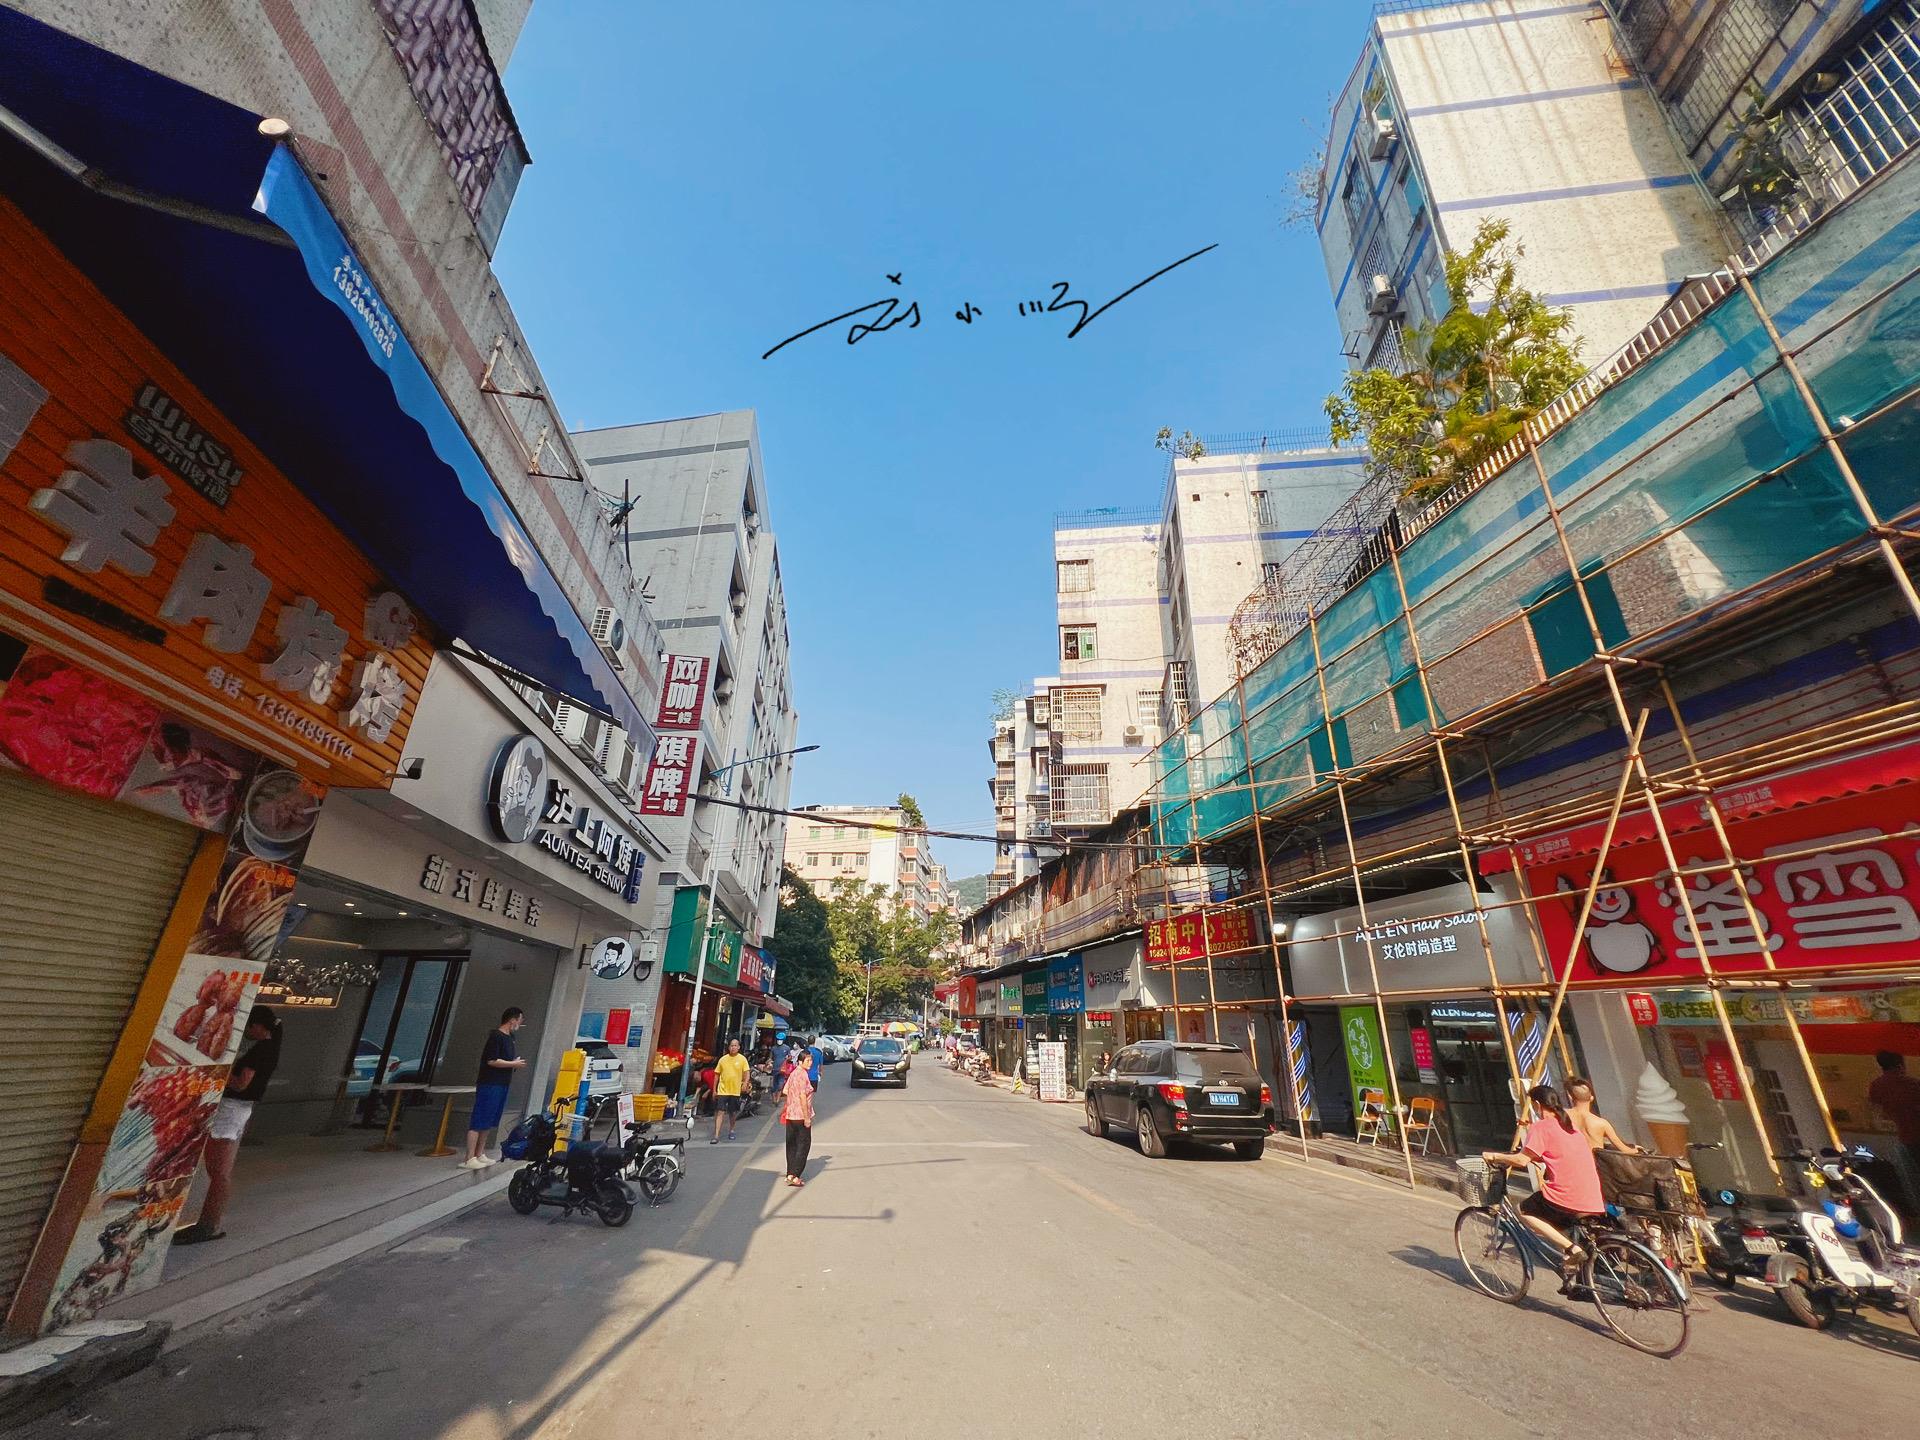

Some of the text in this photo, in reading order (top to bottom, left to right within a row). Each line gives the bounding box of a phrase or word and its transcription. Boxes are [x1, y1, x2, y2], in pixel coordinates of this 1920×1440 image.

[333, 266, 394, 358] 13828492826
[127, 411, 230, 506] 乌苏啤酒
[665, 655, 703, 710] 网咖
[254, 693, 354, 761] 13364891114
[649, 737, 689, 797] 棋牌
[546, 779, 634, 876] 沪上阿姨
[423, 855, 544, 927] 新式鲜果茶
[539, 830, 592, 874] AUNTEA
[595, 865, 627, 894] JENNY
[1655, 822, 1920, 959] 蜜雪
[1148, 918, 1216, 947] 招商中心
[1200, 940, 1250, 953] 130274521
[1355, 911, 1489, 942] ALLEN Hair Salon
[1382, 935, 1458, 960] 艾伦时尚造型
[1430, 1008, 1460, 1017] ALLEN
